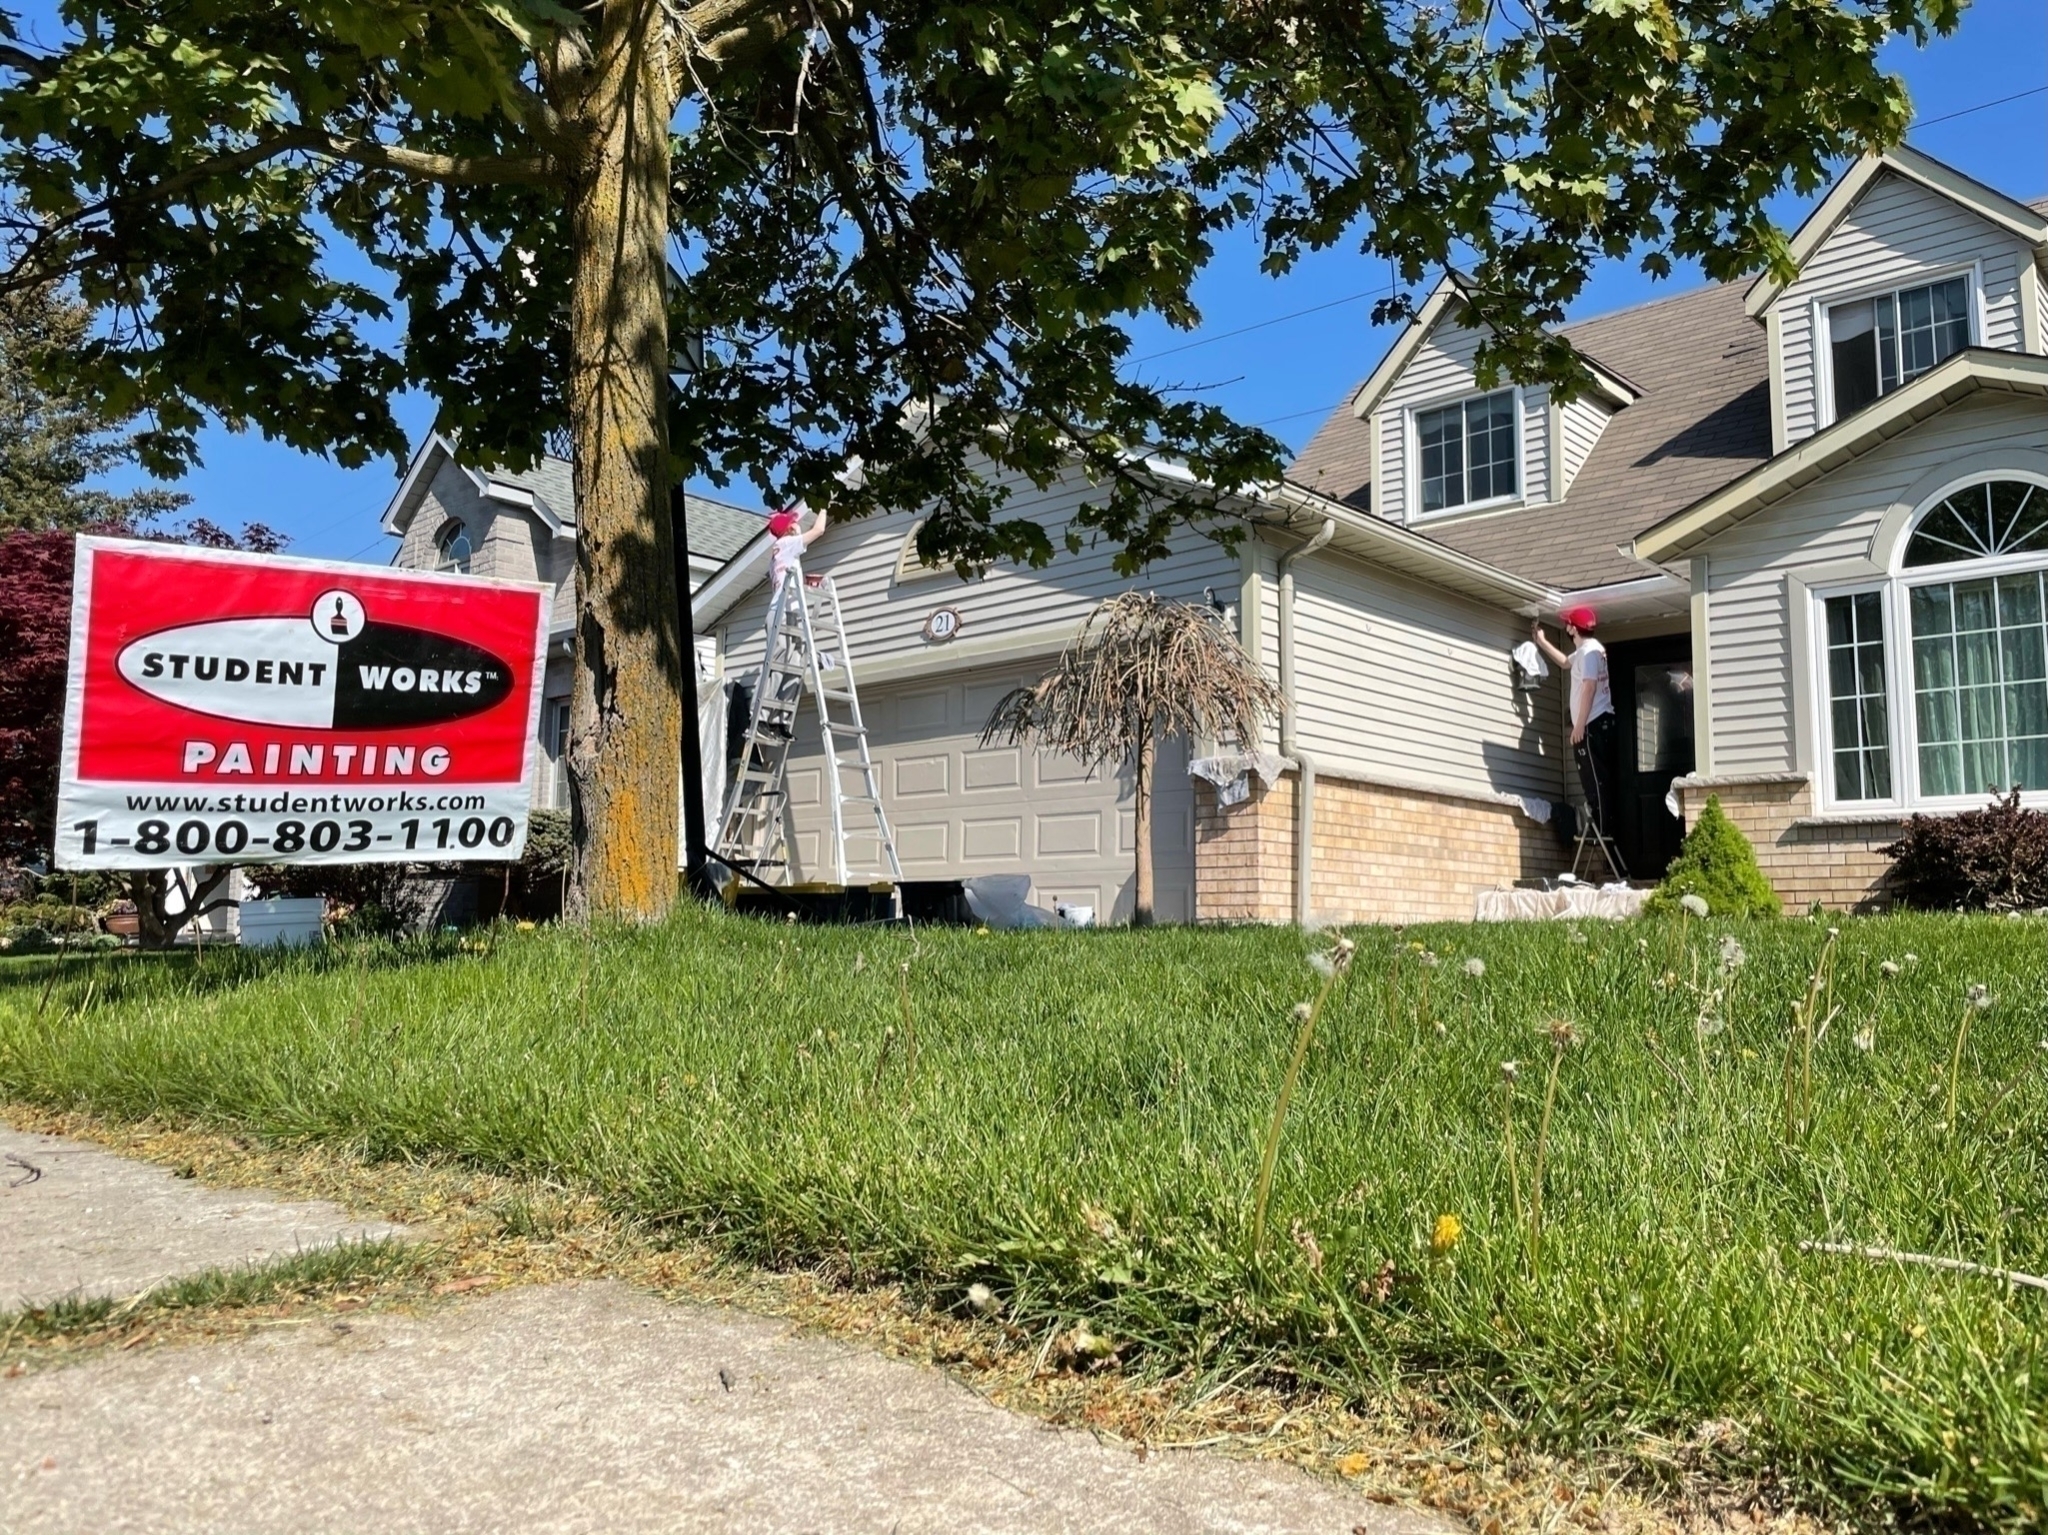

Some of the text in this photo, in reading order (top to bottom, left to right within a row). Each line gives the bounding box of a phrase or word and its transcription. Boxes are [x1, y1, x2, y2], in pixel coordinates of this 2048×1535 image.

[935, 613, 950, 633] 21
[141, 652, 327, 687] STUDENT
[358, 664, 482, 695] WORKS
[182, 739, 451, 777] PAINTING
[126, 791, 486, 813] www.studentworks.com
